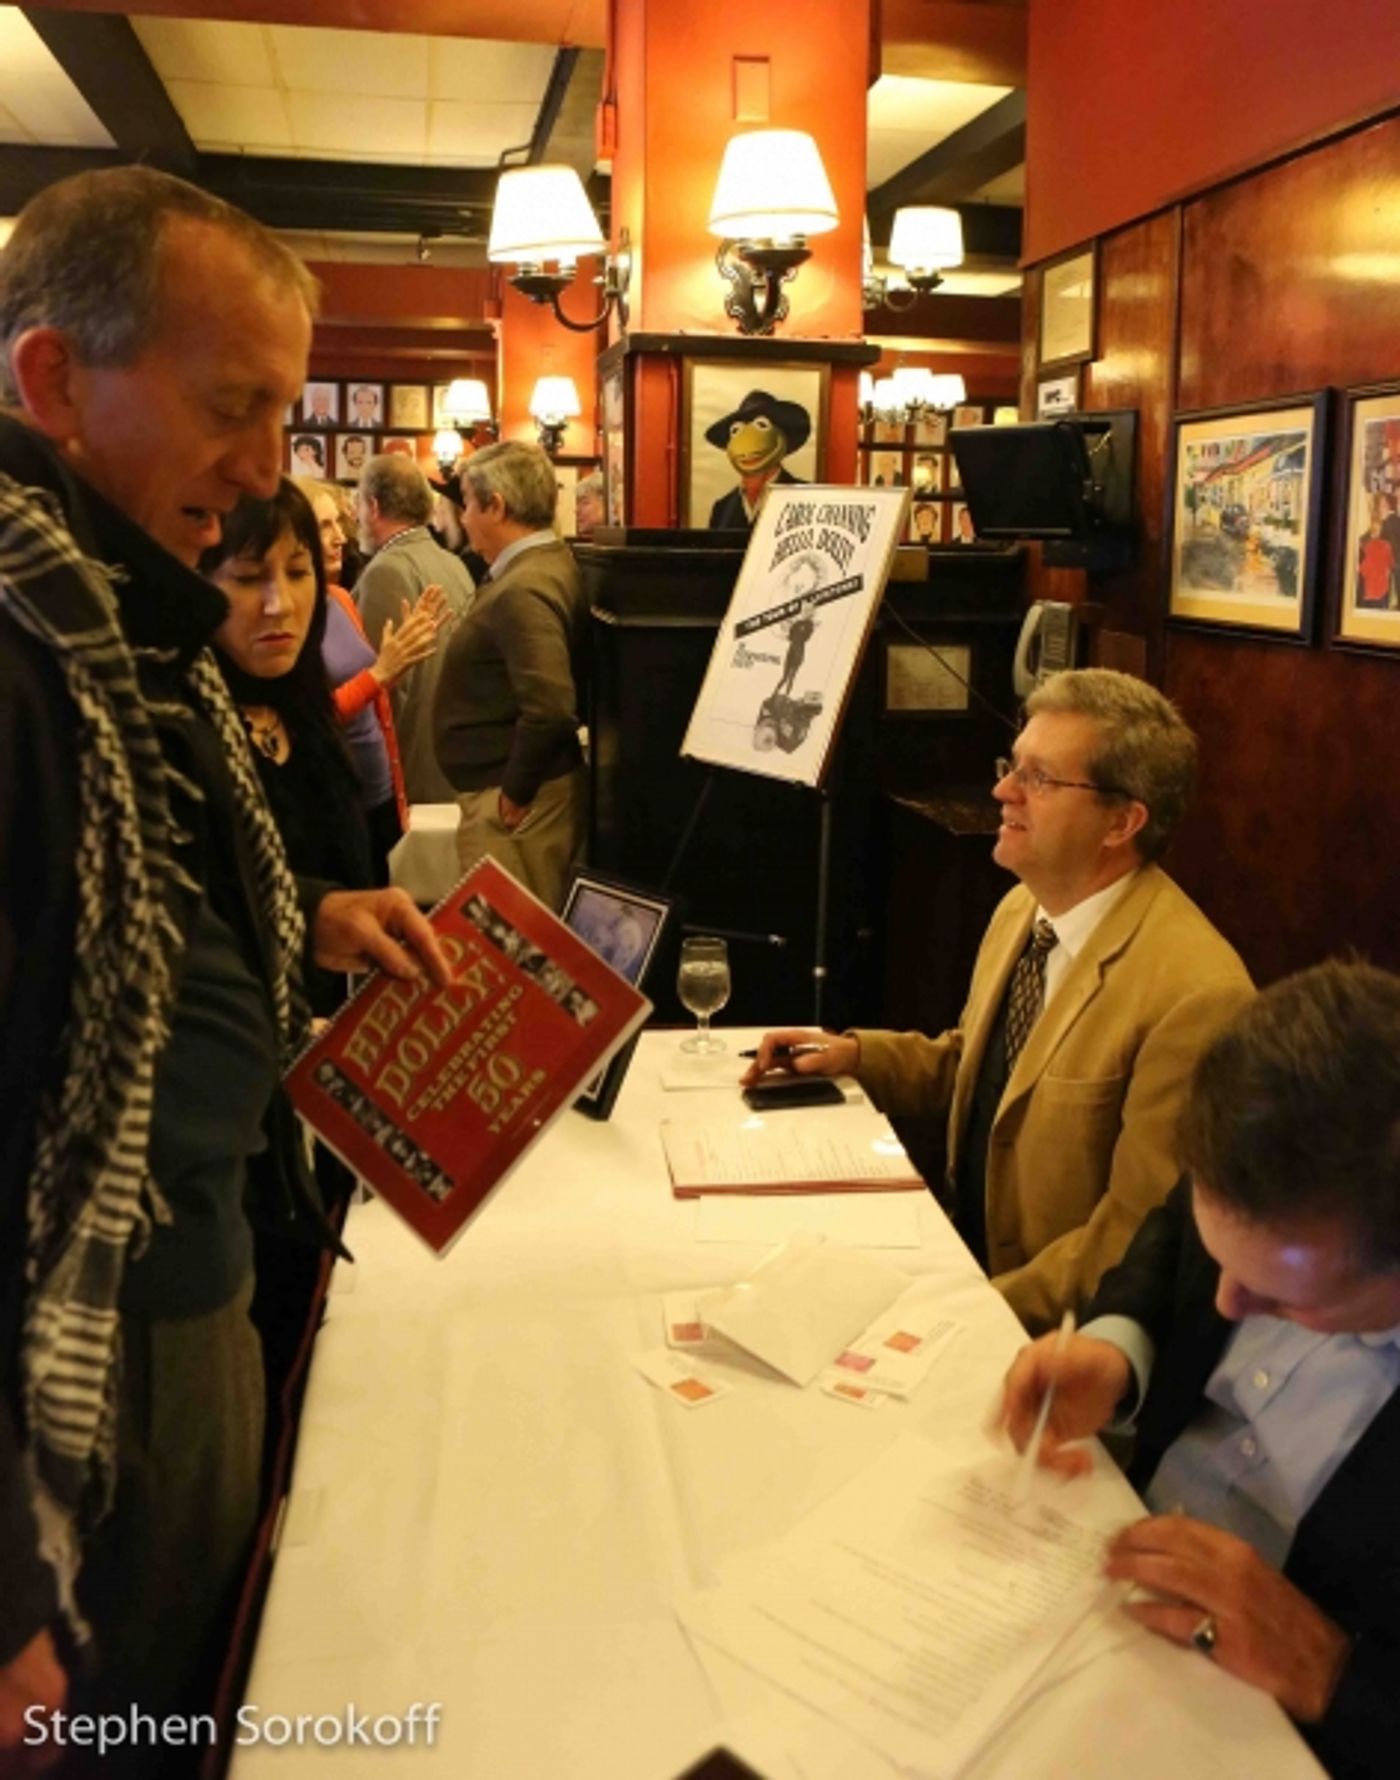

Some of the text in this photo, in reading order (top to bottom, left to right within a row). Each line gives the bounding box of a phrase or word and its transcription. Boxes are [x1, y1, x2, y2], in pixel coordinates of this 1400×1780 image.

[774, 501, 876, 544] CAROL CHANNING
[374, 956, 506, 1107] DOLLY!
[406, 984, 524, 1122] CELEBRATING
[431, 1010, 518, 1112] THE FIRST
[466, 1053, 522, 1115] 50
[487, 1069, 547, 1135] YEARS
